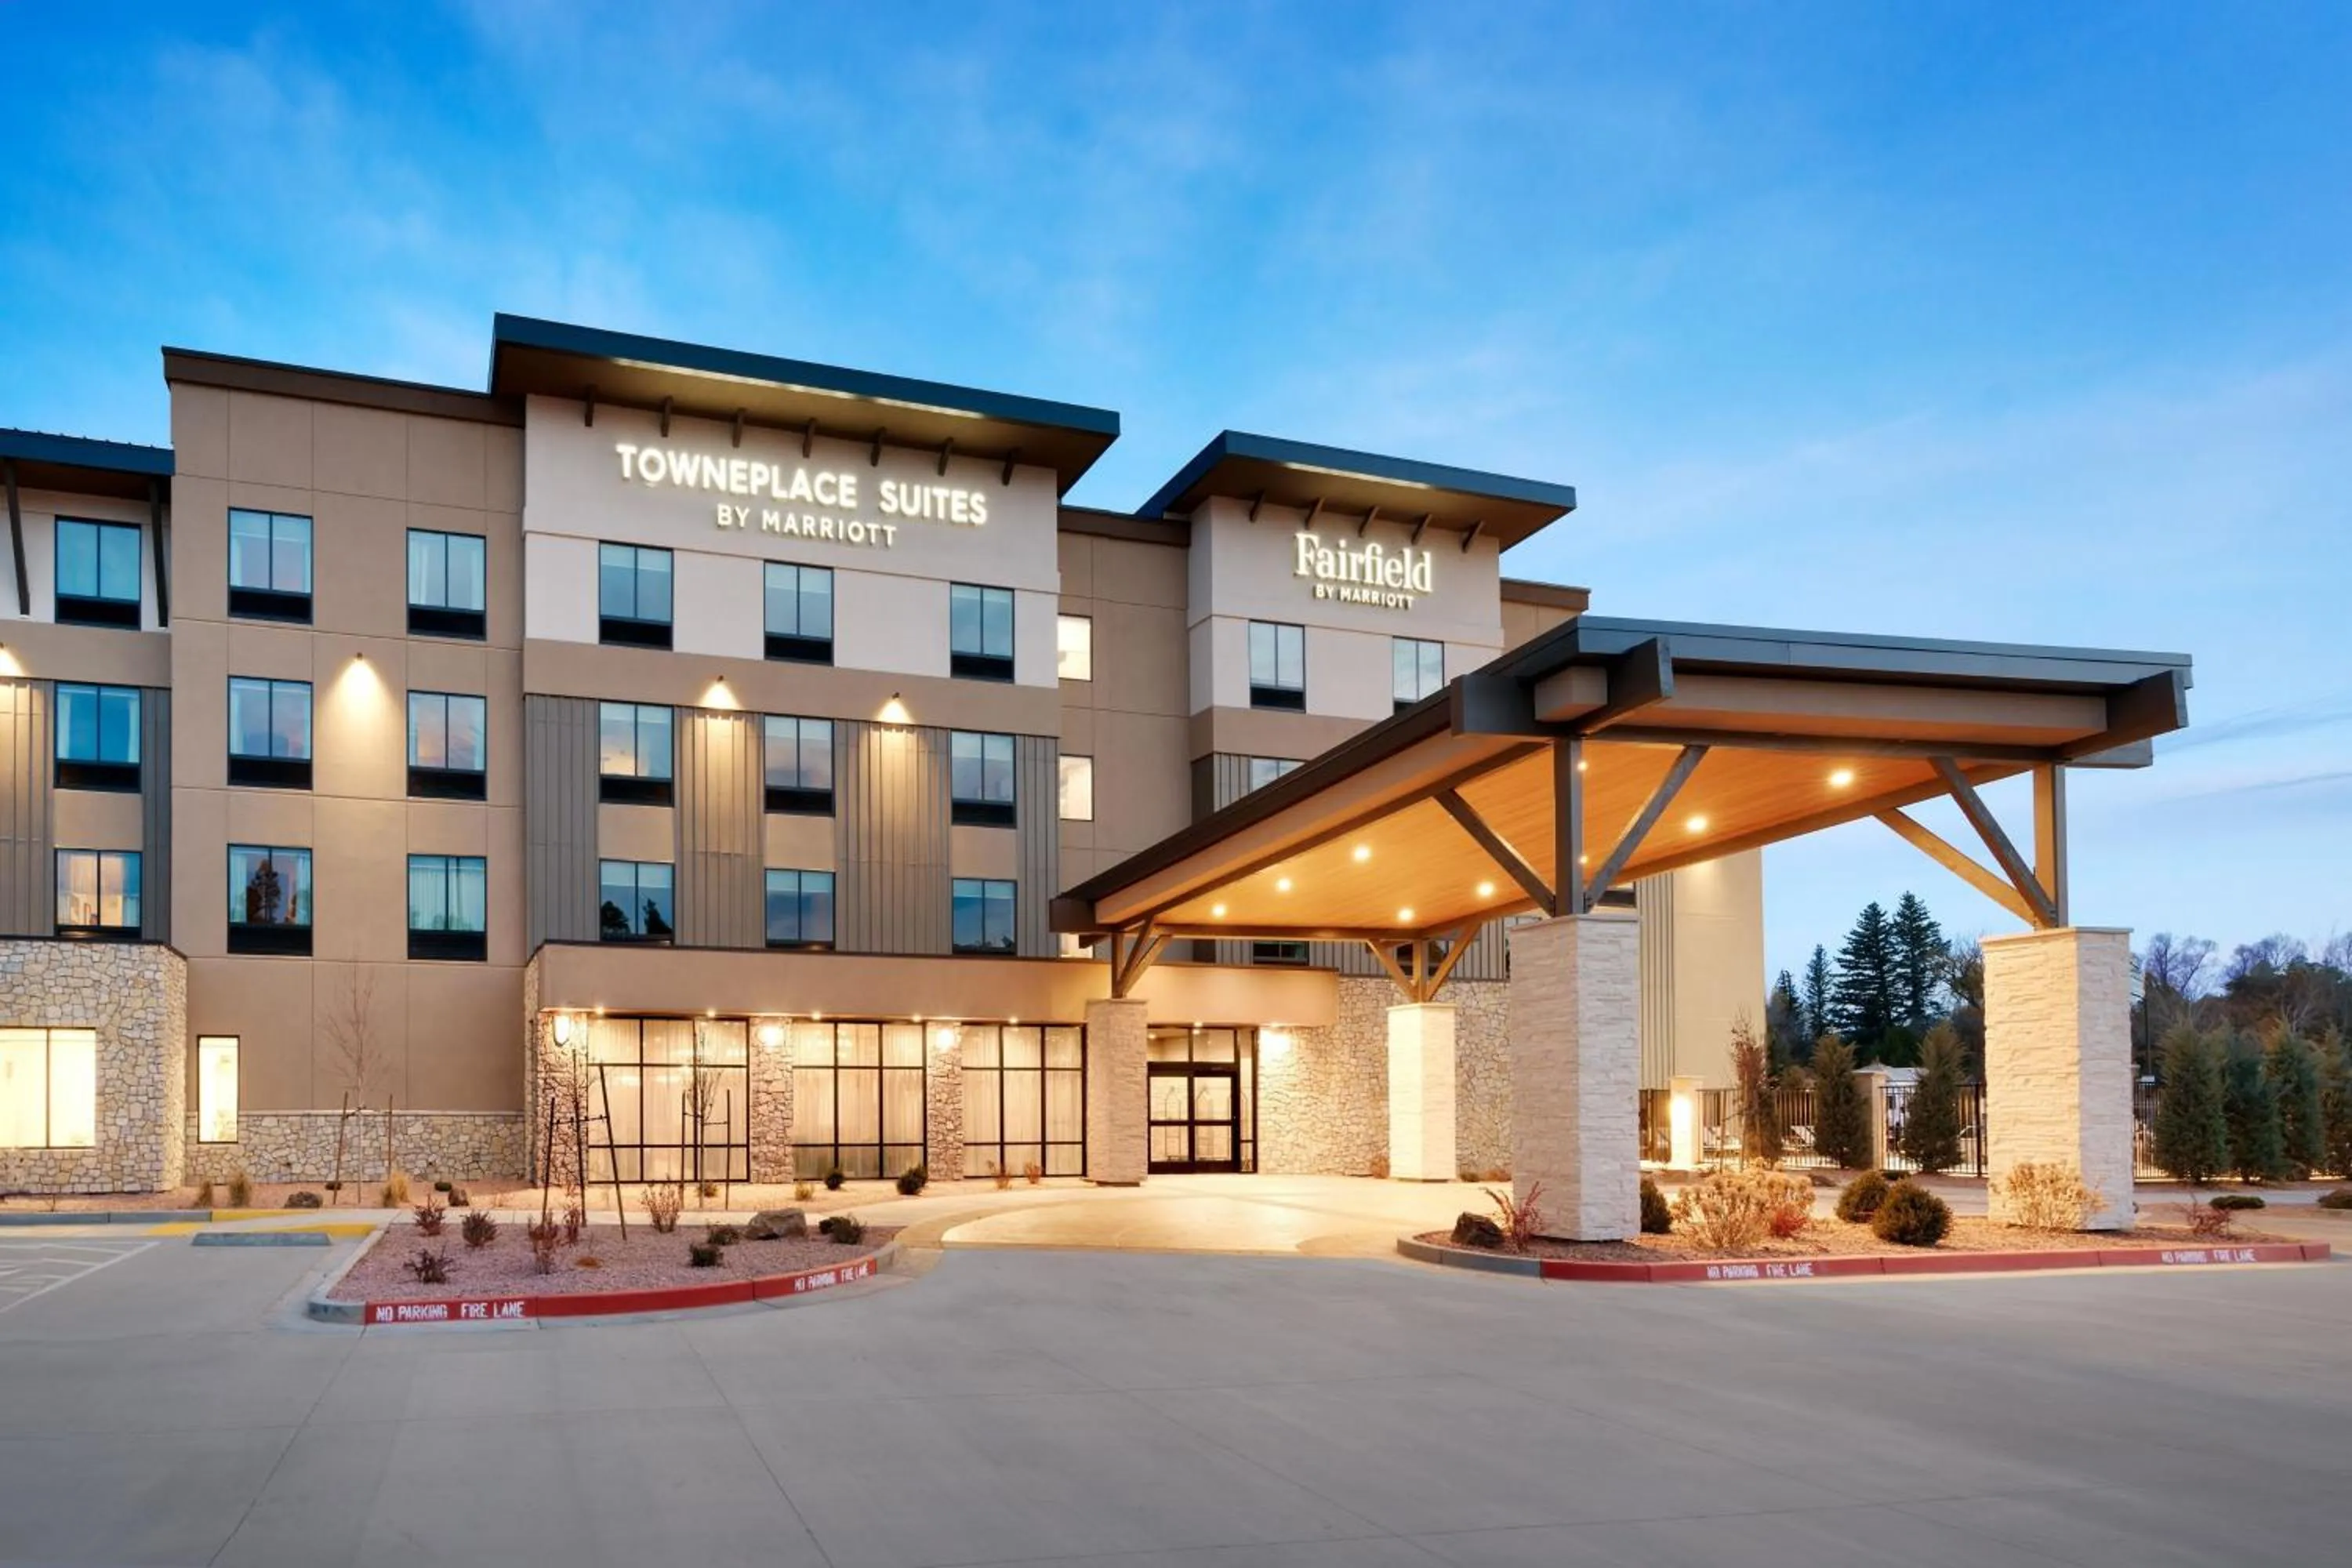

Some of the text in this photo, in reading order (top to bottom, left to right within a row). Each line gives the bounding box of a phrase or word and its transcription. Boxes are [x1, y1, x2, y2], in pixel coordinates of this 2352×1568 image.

[615, 445, 988, 525] TOWNEPLACE SUITES
[717, 503, 897, 547] BY MARRIOTT
[1295, 532, 1432, 593] Fairfield
[1316, 583, 1414, 608] BY MARRIOTT
[2213, 1249, 2230, 1262] FE
[376, 1301, 524, 1322] NO PARKING FIRE LANE
